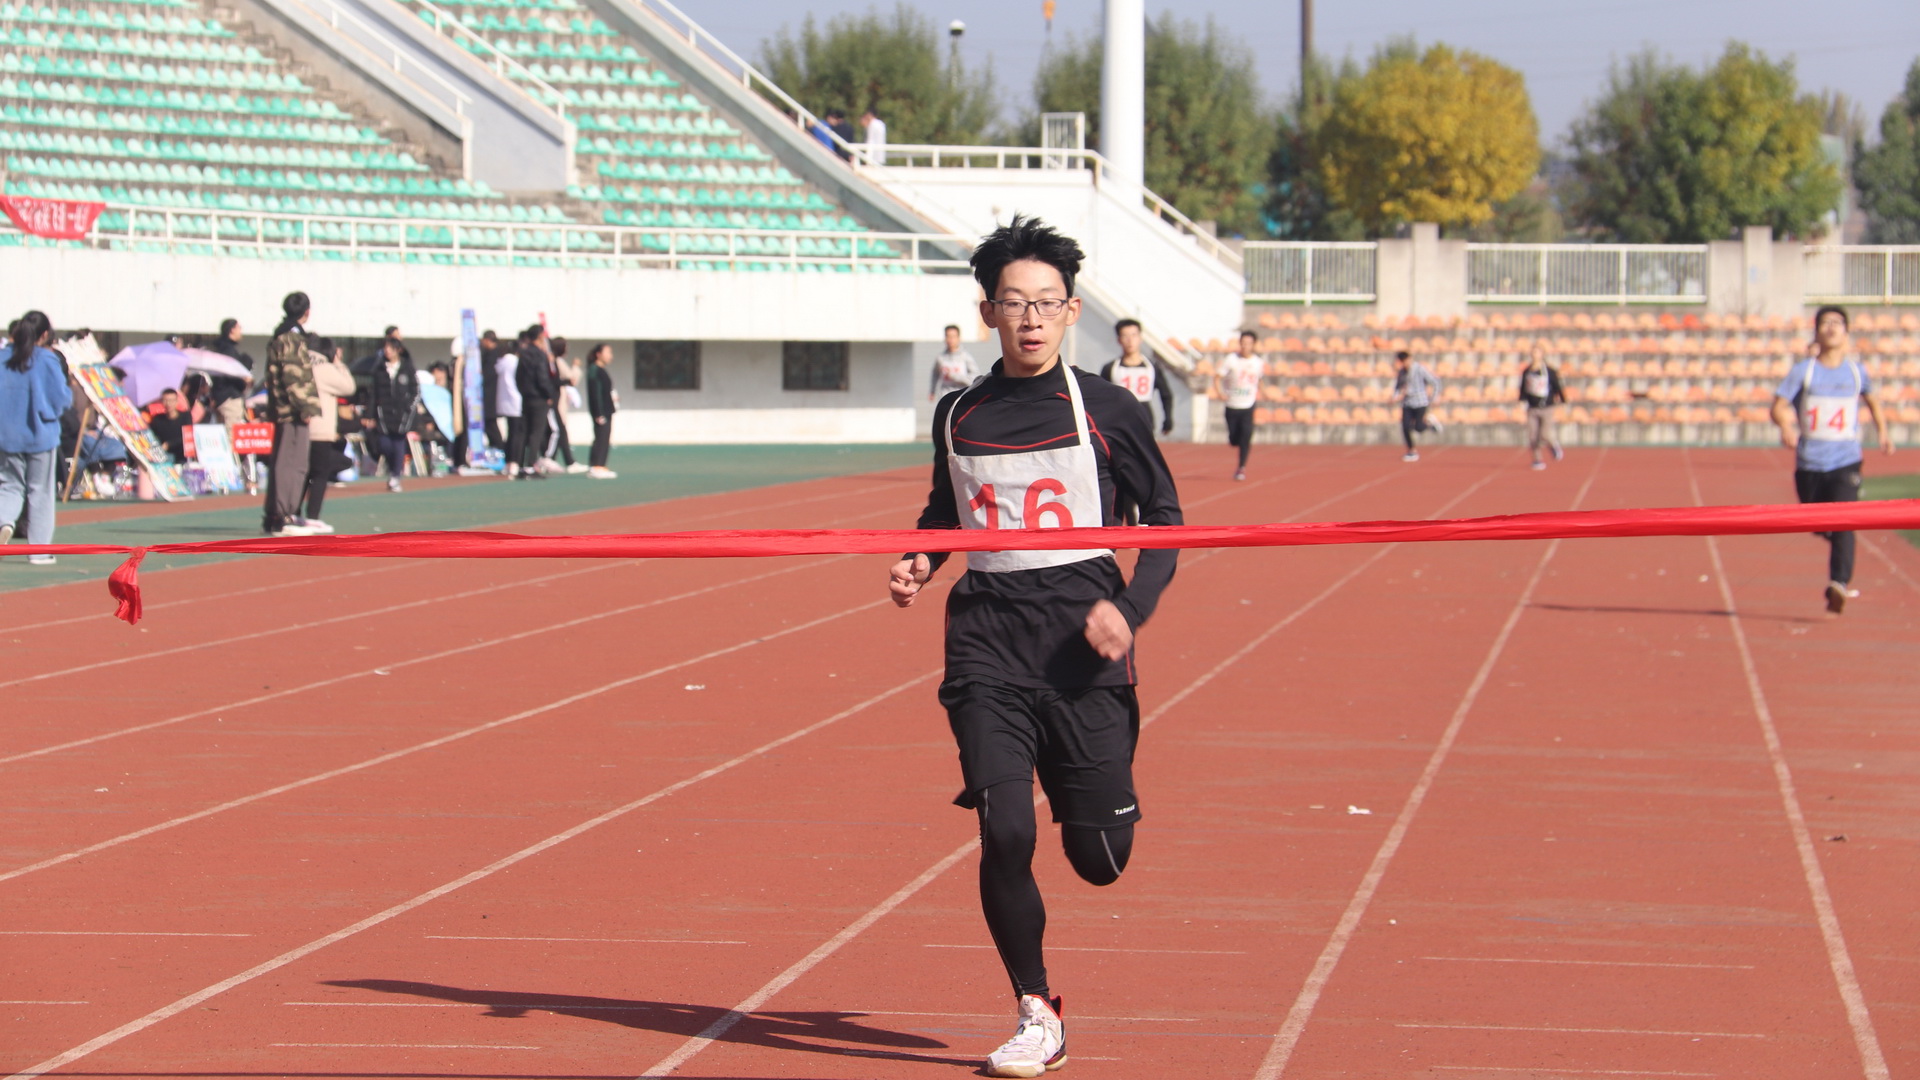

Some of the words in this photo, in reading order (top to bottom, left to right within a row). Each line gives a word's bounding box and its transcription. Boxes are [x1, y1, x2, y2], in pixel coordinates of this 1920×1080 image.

[1120, 376, 1149, 395] 18
[1806, 407, 1845, 432] 14
[969, 478, 1074, 549] 16
